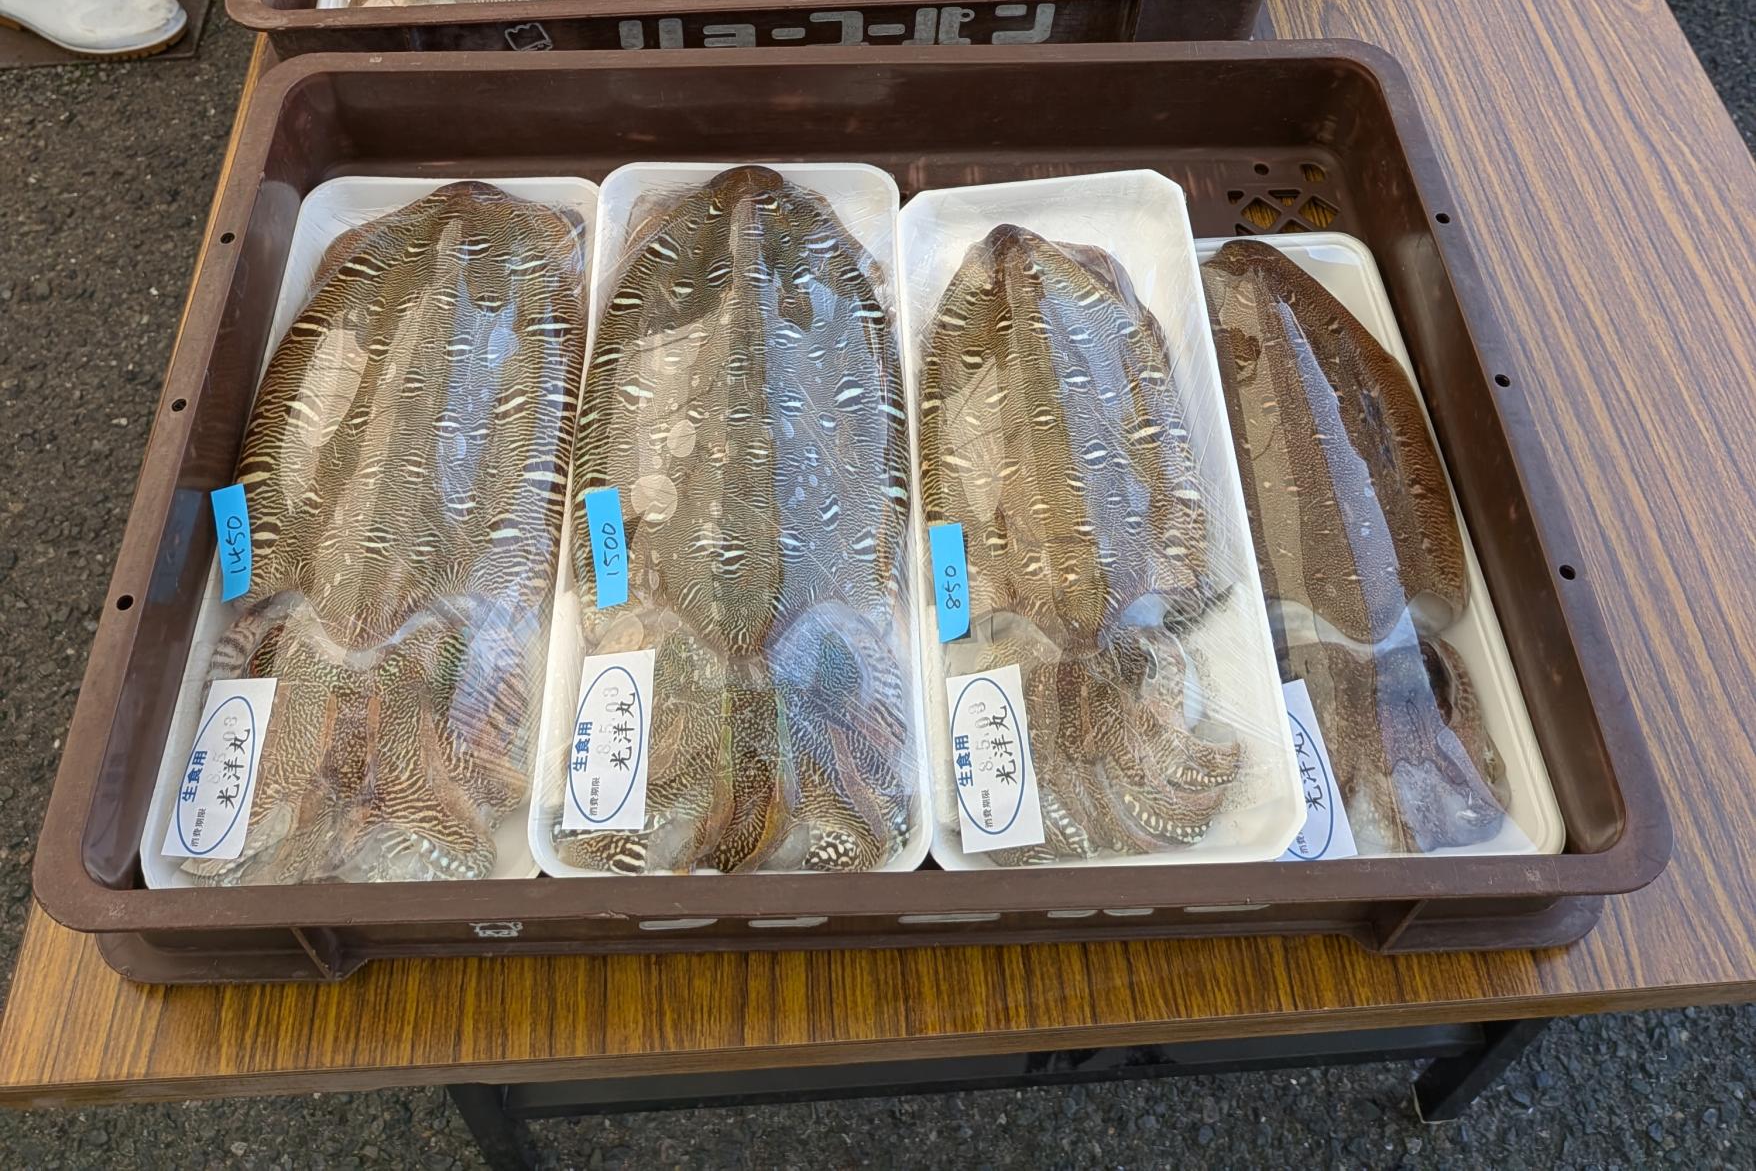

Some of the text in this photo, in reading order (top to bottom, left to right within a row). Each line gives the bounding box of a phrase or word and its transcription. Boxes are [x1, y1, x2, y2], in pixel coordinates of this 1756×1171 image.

[225, 516, 247, 574] 1450
[601, 522, 620, 576] 1500
[944, 565, 961, 610] 850
[573, 721, 593, 772] 生食用
[610, 692, 635, 771] 光洋丸
[989, 705, 1017, 786] 光洋丸
[182, 750, 208, 803] 生食用
[217, 729, 250, 809] 光洋丸
[954, 734, 974, 787] 生食用
[589, 777, 601, 816] 消費期限
[979, 790, 994, 829] 消費期限
[190, 808, 206, 847] 消費期限
